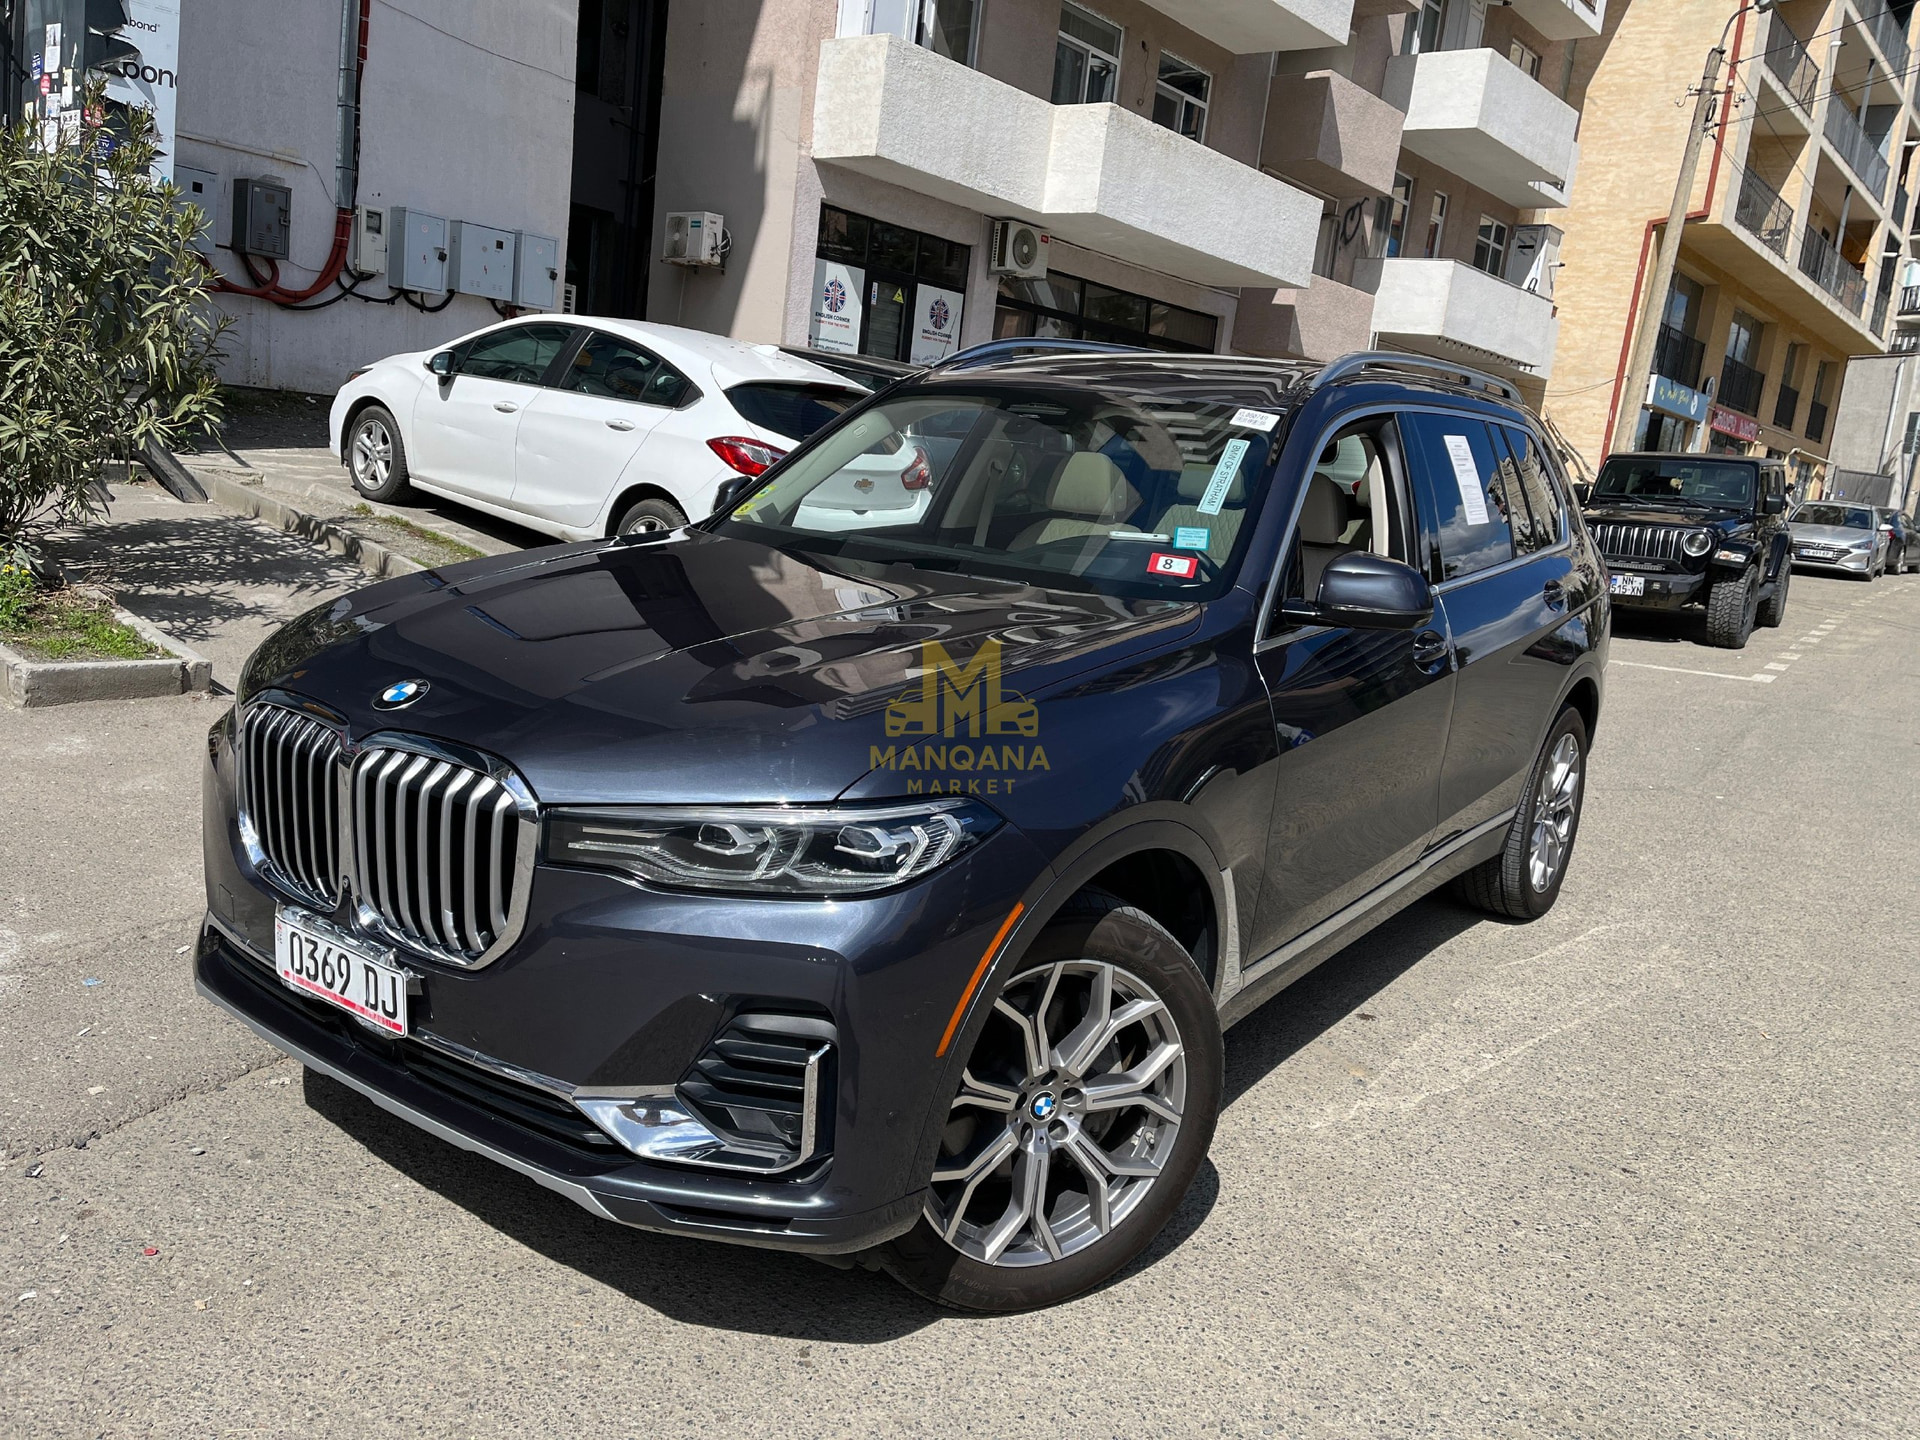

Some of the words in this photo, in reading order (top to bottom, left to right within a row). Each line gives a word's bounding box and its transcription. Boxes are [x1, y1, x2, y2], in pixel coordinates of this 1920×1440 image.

[122, 61, 177, 88] bon
[1224, 461, 1234, 470] OF
[1163, 559, 1173, 570] 8
[289, 931, 351, 996] 0369
[363, 962, 398, 1020] DJ
